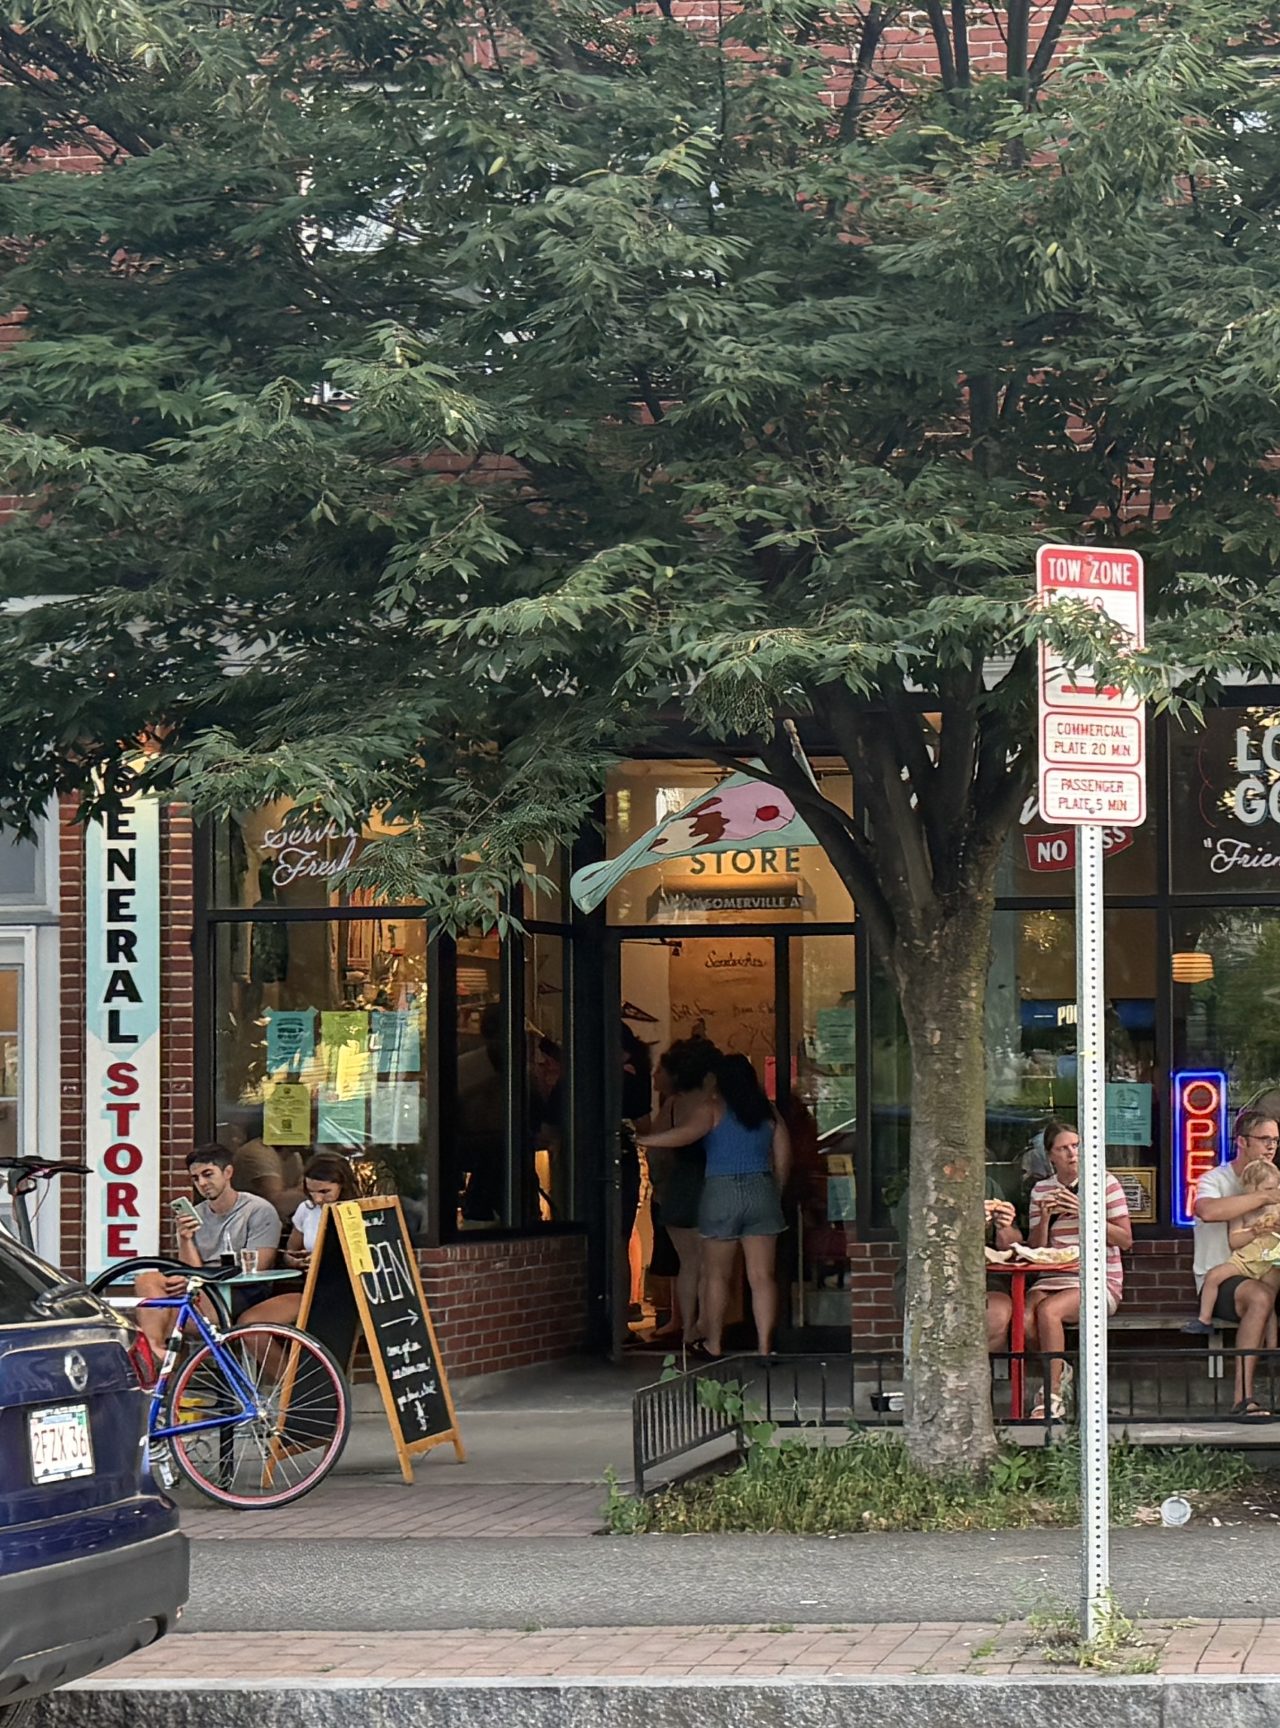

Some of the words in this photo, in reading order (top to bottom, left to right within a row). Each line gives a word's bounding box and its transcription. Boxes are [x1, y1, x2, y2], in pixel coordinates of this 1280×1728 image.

[1047, 558, 1081, 582] TOW
[1089, 561, 1133, 586] ZONE
[1057, 722, 1127, 738] COMMERCIAL
[1054, 741, 1087, 755] PLATE
[1091, 743, 1107, 756] 20
[1111, 744, 1131, 756] MIN
[1061, 778, 1124, 793] PASSENGER
[1058, 797, 1091, 810] PLATE
[1095, 799, 1103, 811] 5
[1108, 799, 1128, 811] MIN
[690, 847, 800, 874] STORE
[1038, 840, 1068, 863] NO
[104, 1062, 144, 1258] STORE
